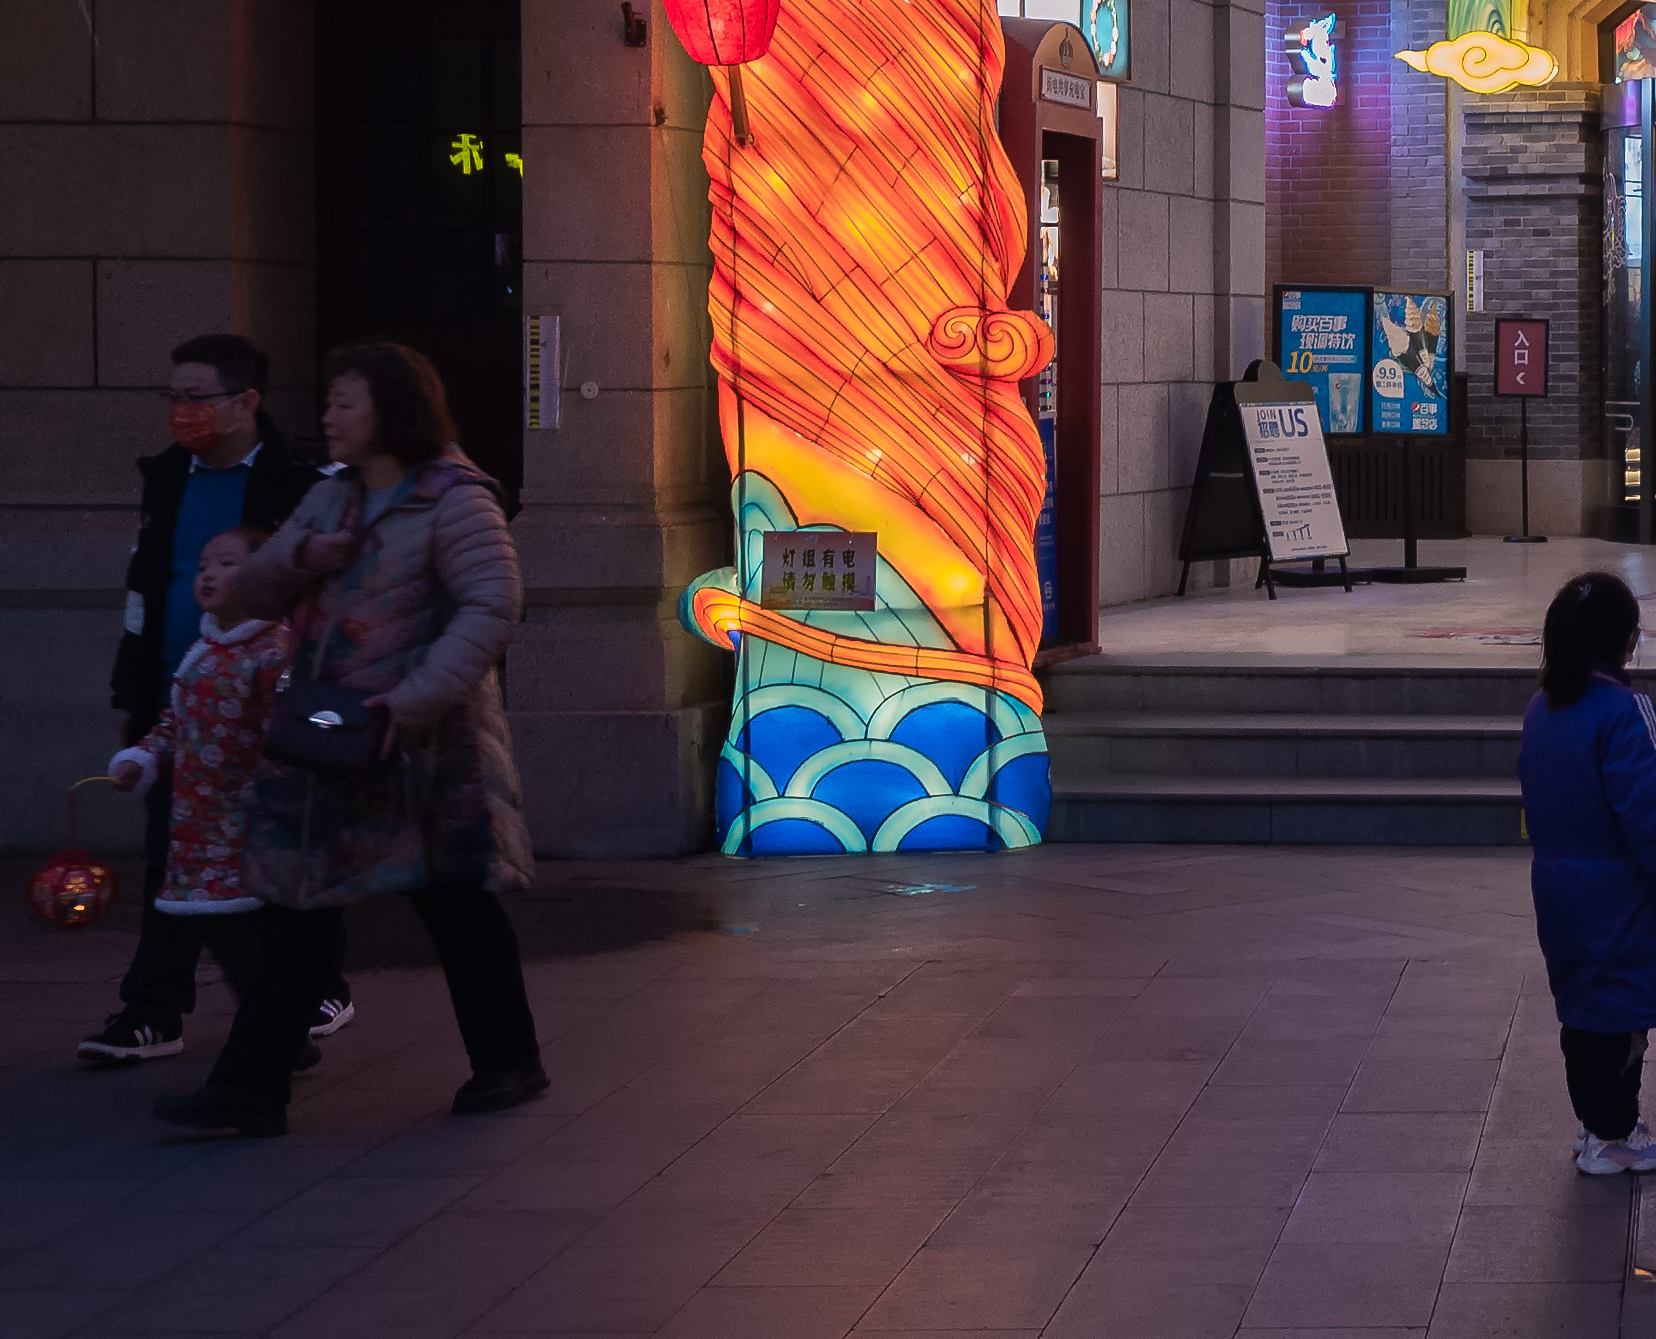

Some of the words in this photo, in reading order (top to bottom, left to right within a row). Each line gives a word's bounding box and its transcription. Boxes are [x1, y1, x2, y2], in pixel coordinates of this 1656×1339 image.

[1291, 314, 1348, 332] 购买百事
[1299, 332, 1356, 349] 现调特饮
[1514, 330, 1530, 365] 入口
[1286, 351, 1313, 374] 10
[1257, 409, 1277, 422] JOIN
[1278, 408, 1309, 438] US
[782, 547, 857, 569] 灯组有电
[782, 571, 857, 592] 请勿触摸
